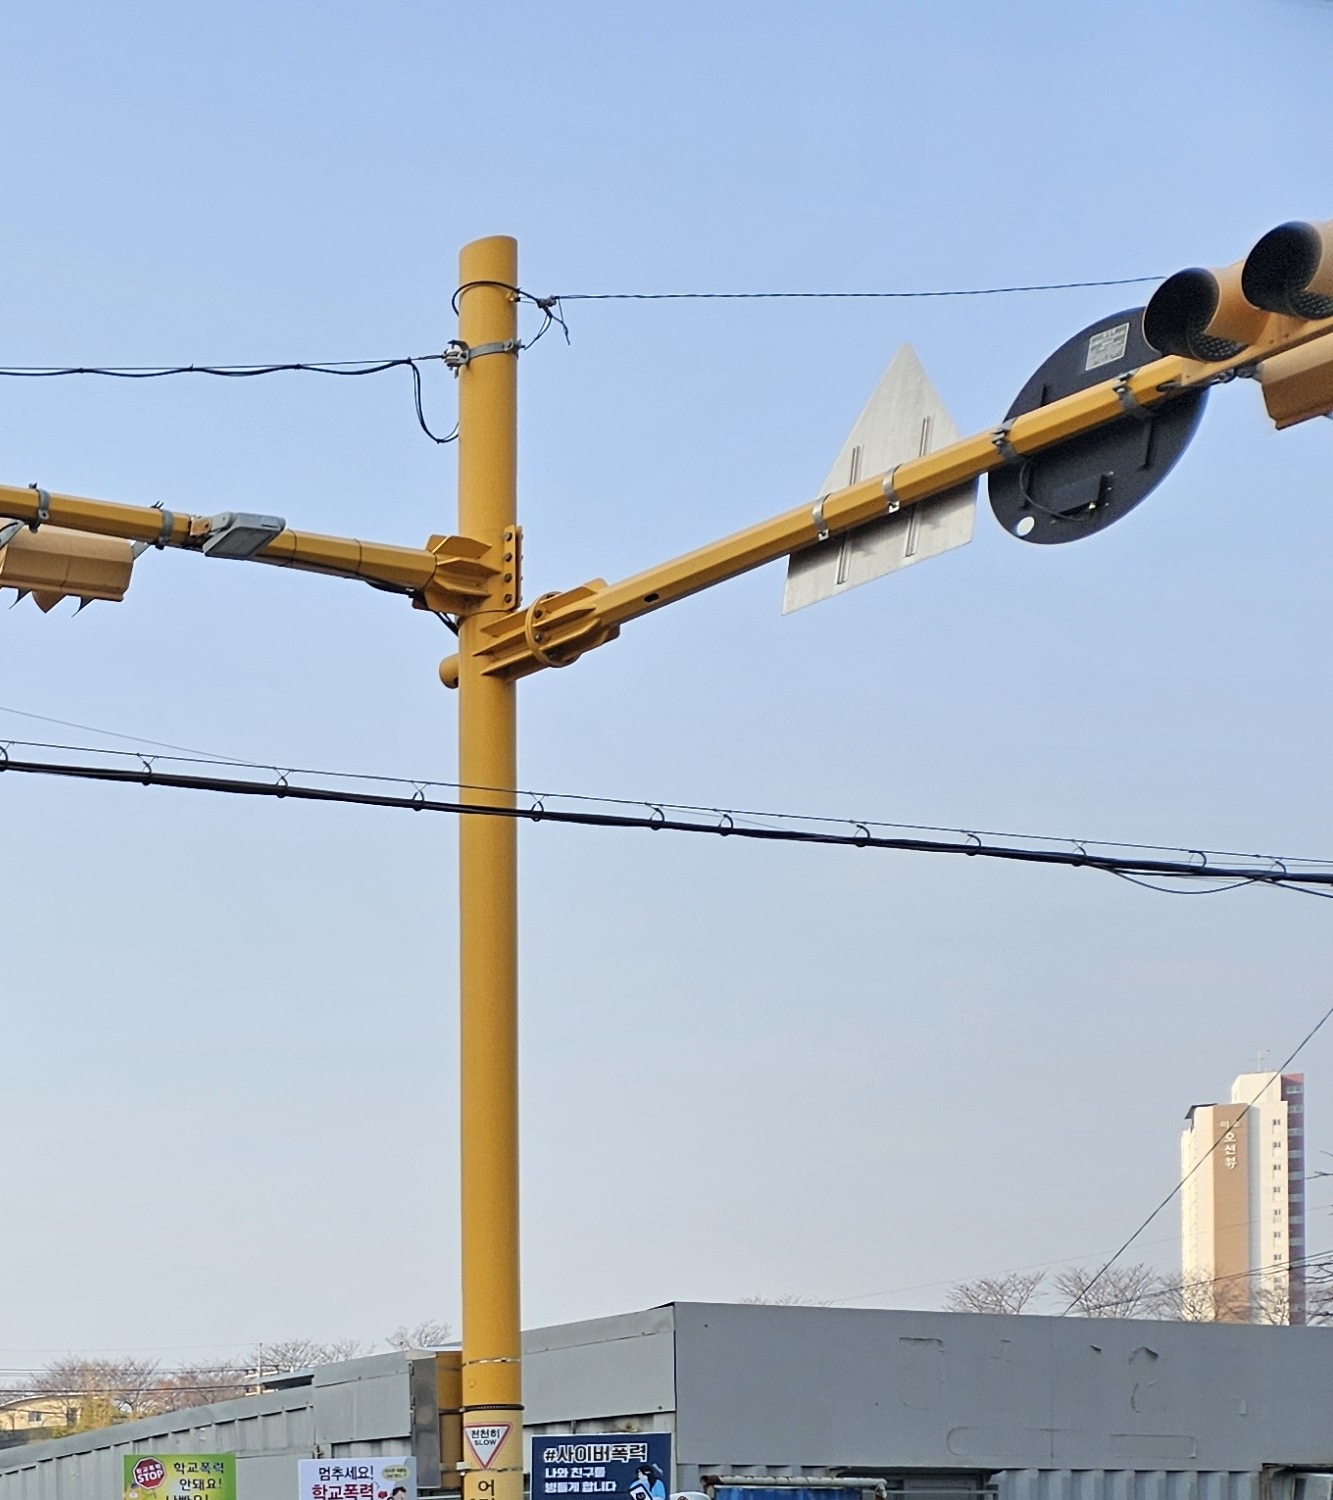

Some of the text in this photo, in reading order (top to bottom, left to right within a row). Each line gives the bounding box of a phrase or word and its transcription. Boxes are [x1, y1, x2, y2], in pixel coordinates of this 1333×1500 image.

[471, 1428, 500, 1439] 천천히
[543, 1442, 648, 1463] #사이버폭력
[173, 1462, 224, 1475] 학교폭력
[318, 1465, 374, 1481] 멈추세요!
[545, 1466, 606, 1478] 나와 친구를
[137, 1469, 164, 1483] STOP
[179, 1478, 222, 1491] 안돼요!
[544, 1480, 617, 1493] 병들게 합니다
